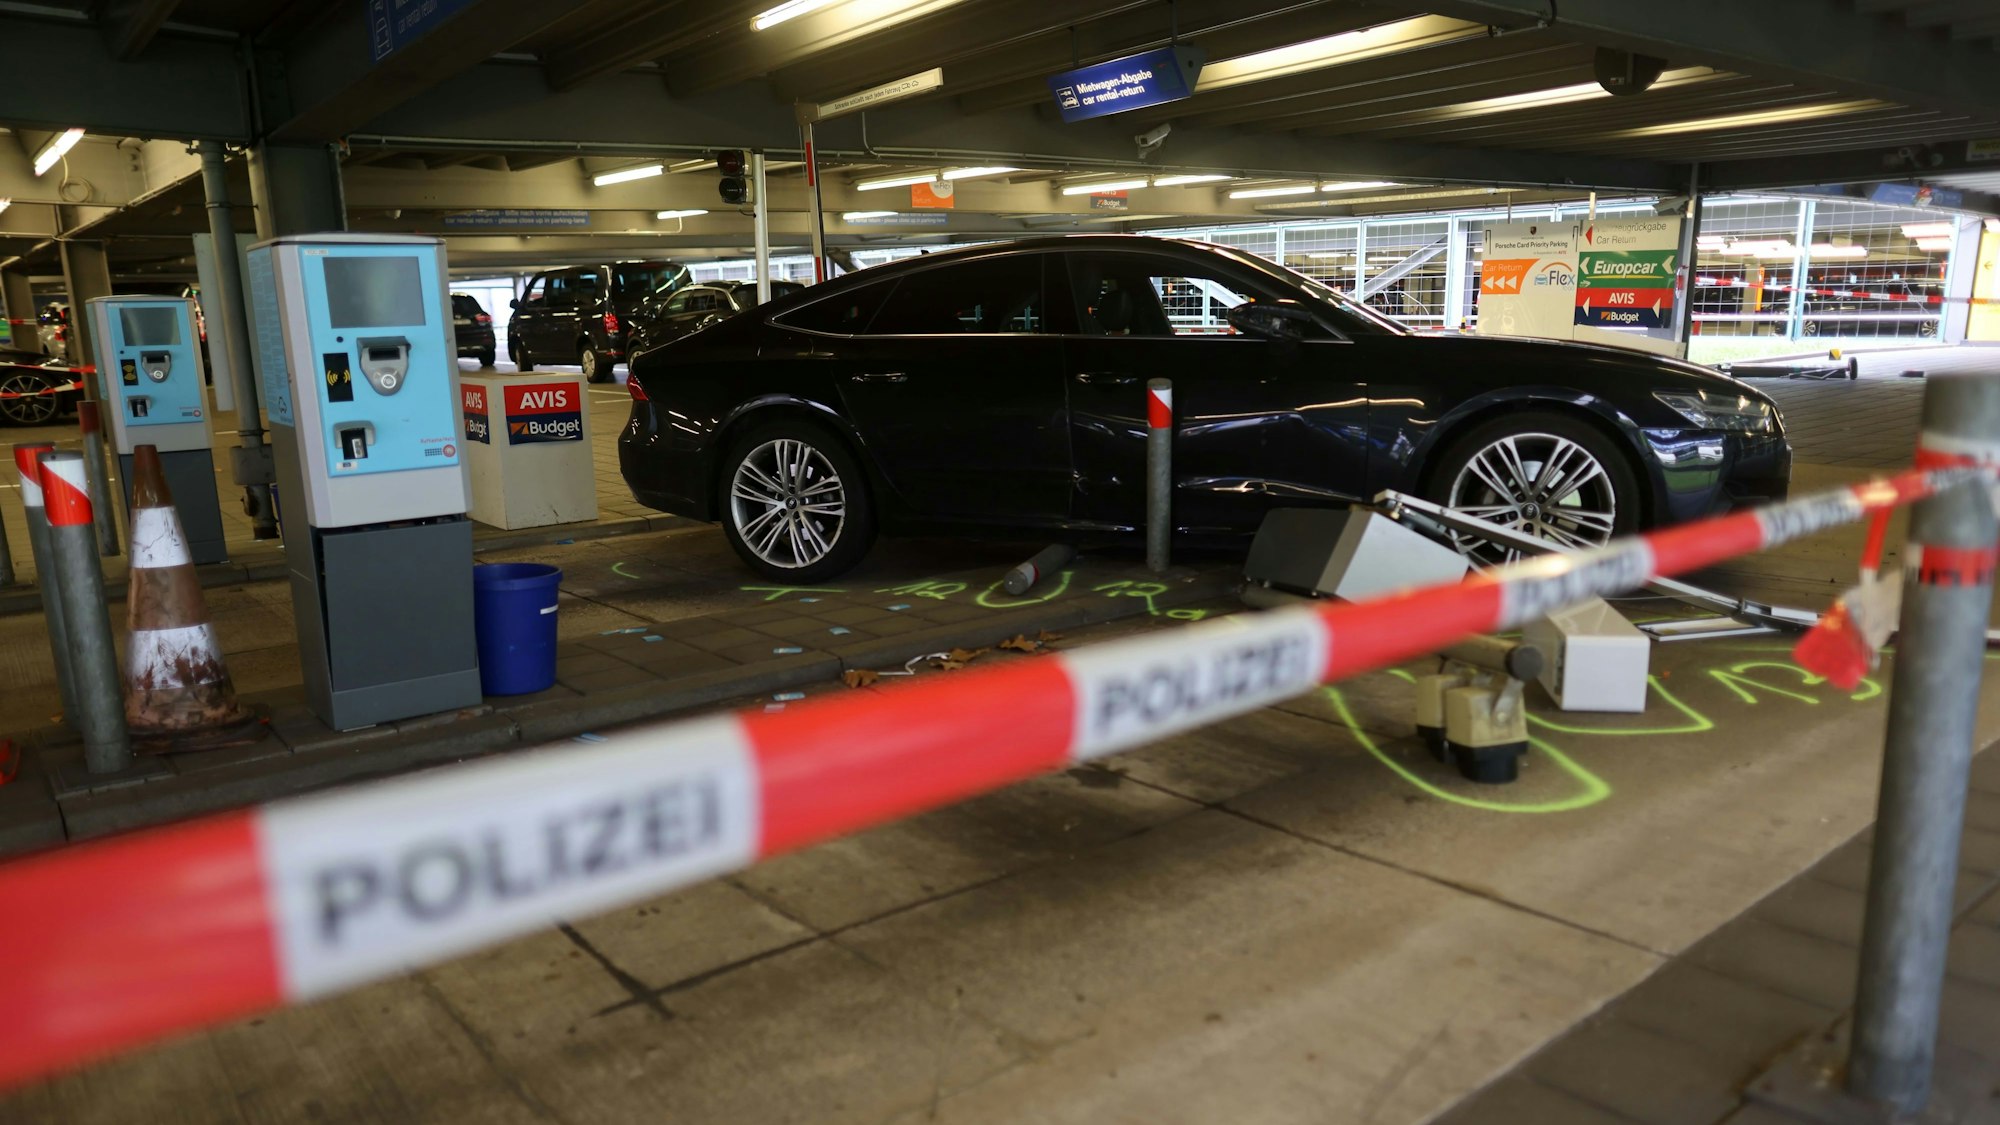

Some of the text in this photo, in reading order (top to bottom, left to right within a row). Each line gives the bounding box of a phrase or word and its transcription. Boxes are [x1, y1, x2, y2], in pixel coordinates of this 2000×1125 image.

[1076, 69, 1153, 95] Mietwagen-Abgabe
[884, 86, 901, 97] Fahrzeug
[1082, 85, 1145, 106] car rental-return
[1597, 222, 1667, 233] eugrückgabe
[1495, 240, 1568, 249] Porsche Card Priority Parking
[1596, 235, 1637, 245] Car Return
[1483, 264, 1523, 272] Car Return
[1593, 260, 1658, 279] Europcar
[1549, 270, 1575, 286] Flex
[1608, 292, 1635, 304] AVIS
[1611, 311, 1640, 324] Budget
[465, 391, 483, 409] AVIS
[520, 390, 567, 410] AVIS
[529, 419, 580, 437] Budget
[1096, 631, 1312, 736] POLIZEI
[314, 771, 724, 945] POLIZEI
